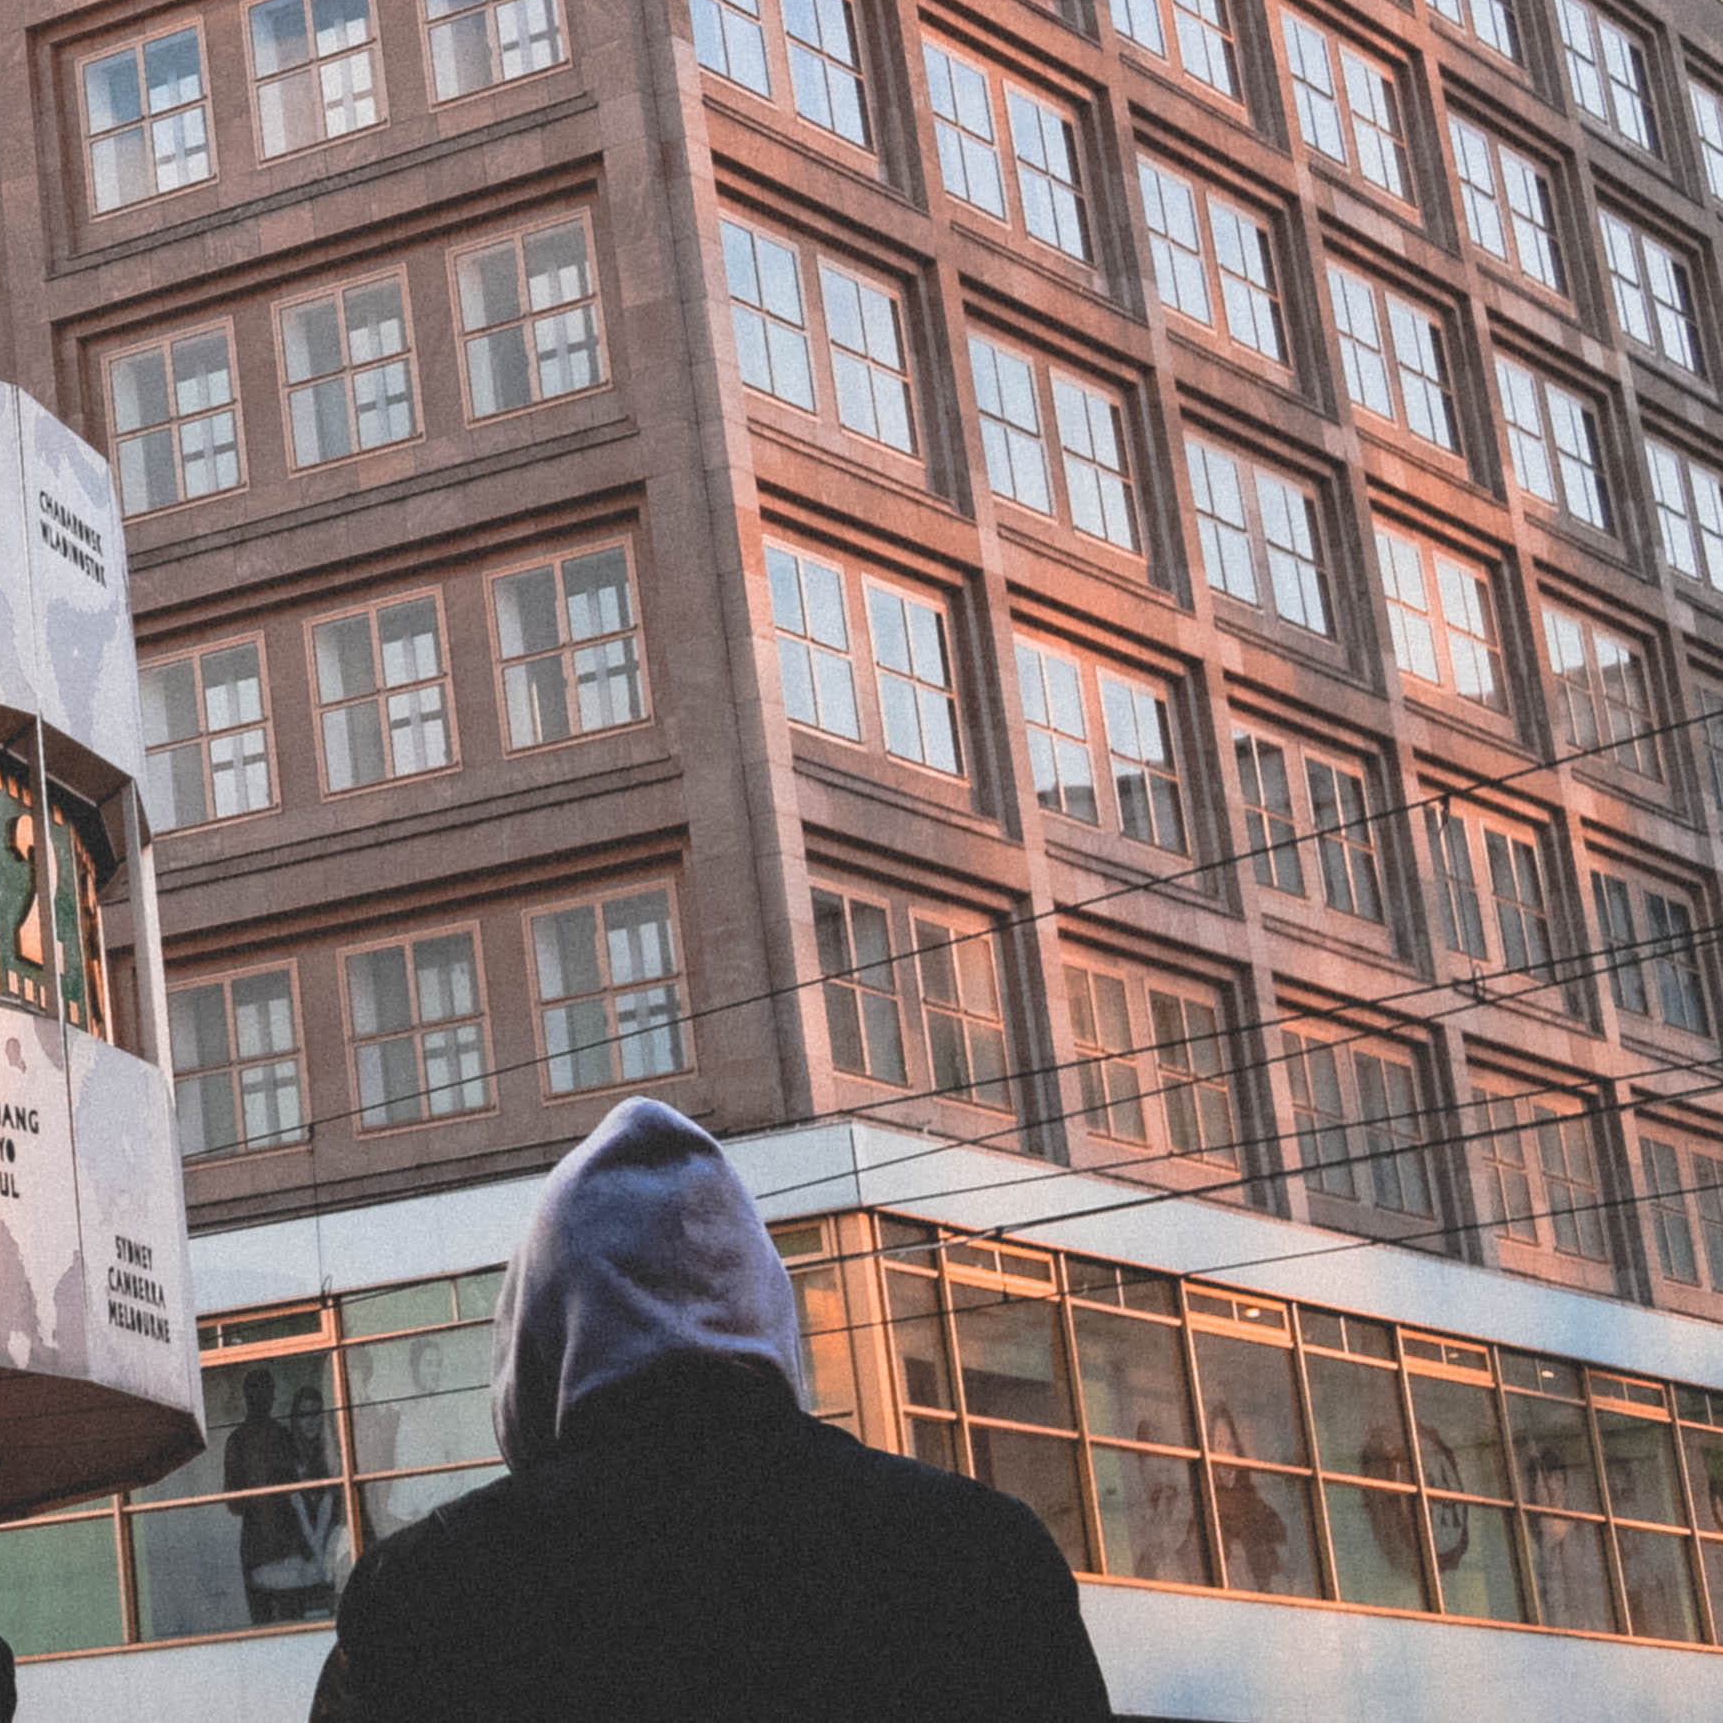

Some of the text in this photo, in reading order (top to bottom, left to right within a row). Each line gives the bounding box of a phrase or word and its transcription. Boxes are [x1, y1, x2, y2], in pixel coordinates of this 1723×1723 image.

[115, 1235, 152, 1272] SYDNEY
[108, 1266, 166, 1308] CANBERRA
[108, 1299, 171, 1344] MELBOURNE
